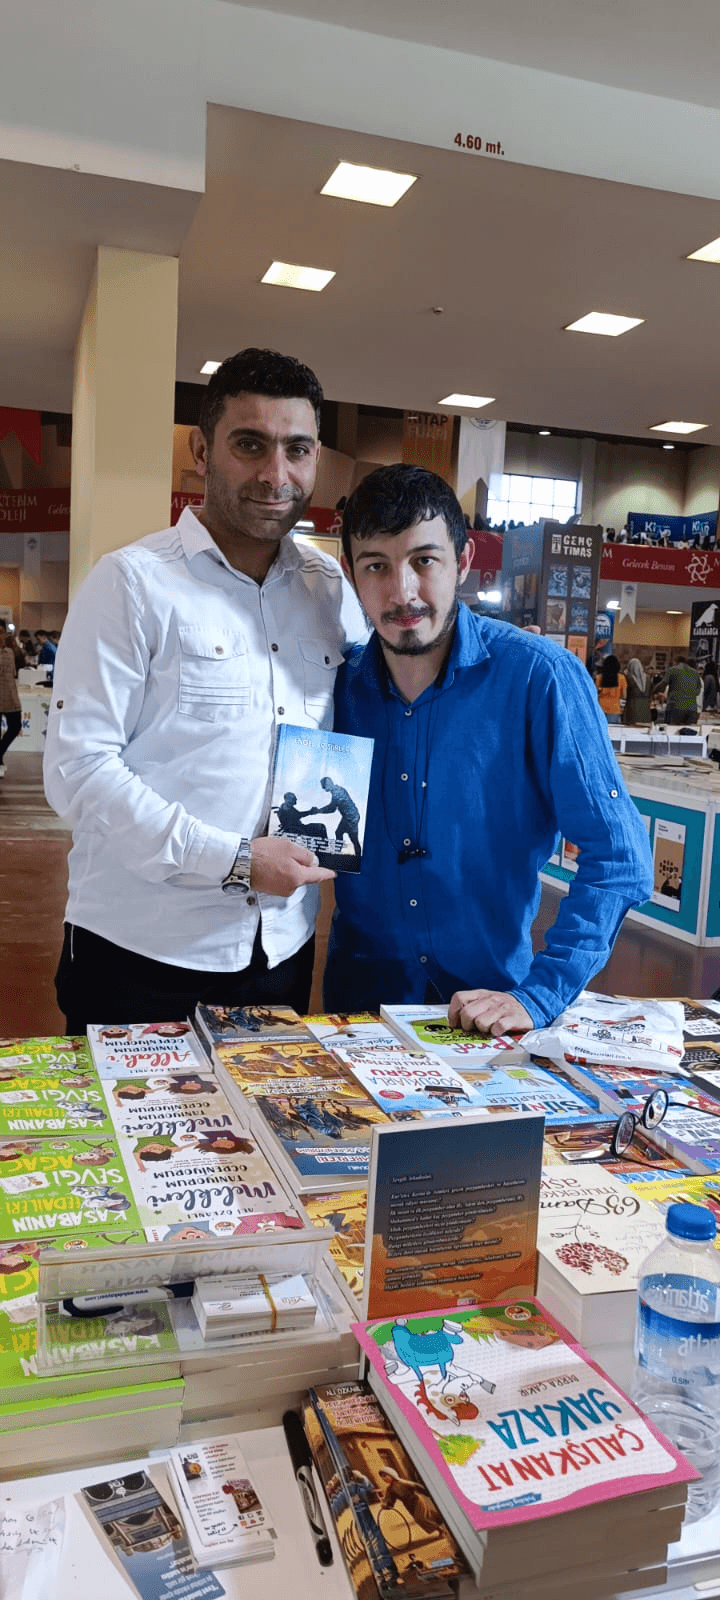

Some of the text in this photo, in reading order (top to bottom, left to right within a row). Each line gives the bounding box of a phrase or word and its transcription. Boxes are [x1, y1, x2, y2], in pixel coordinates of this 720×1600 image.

[454, 133, 505, 156] 4.60 mt.
[147, 1181, 277, 1212] Melekleri
[541, 1194, 641, 1218] 63 Dam
[12, 1209, 127, 1233] KASABANIN
[486, 1387, 623, 1451] YAKAZA
[476, 1423, 645, 1492] ÇALIŞKAN AT
